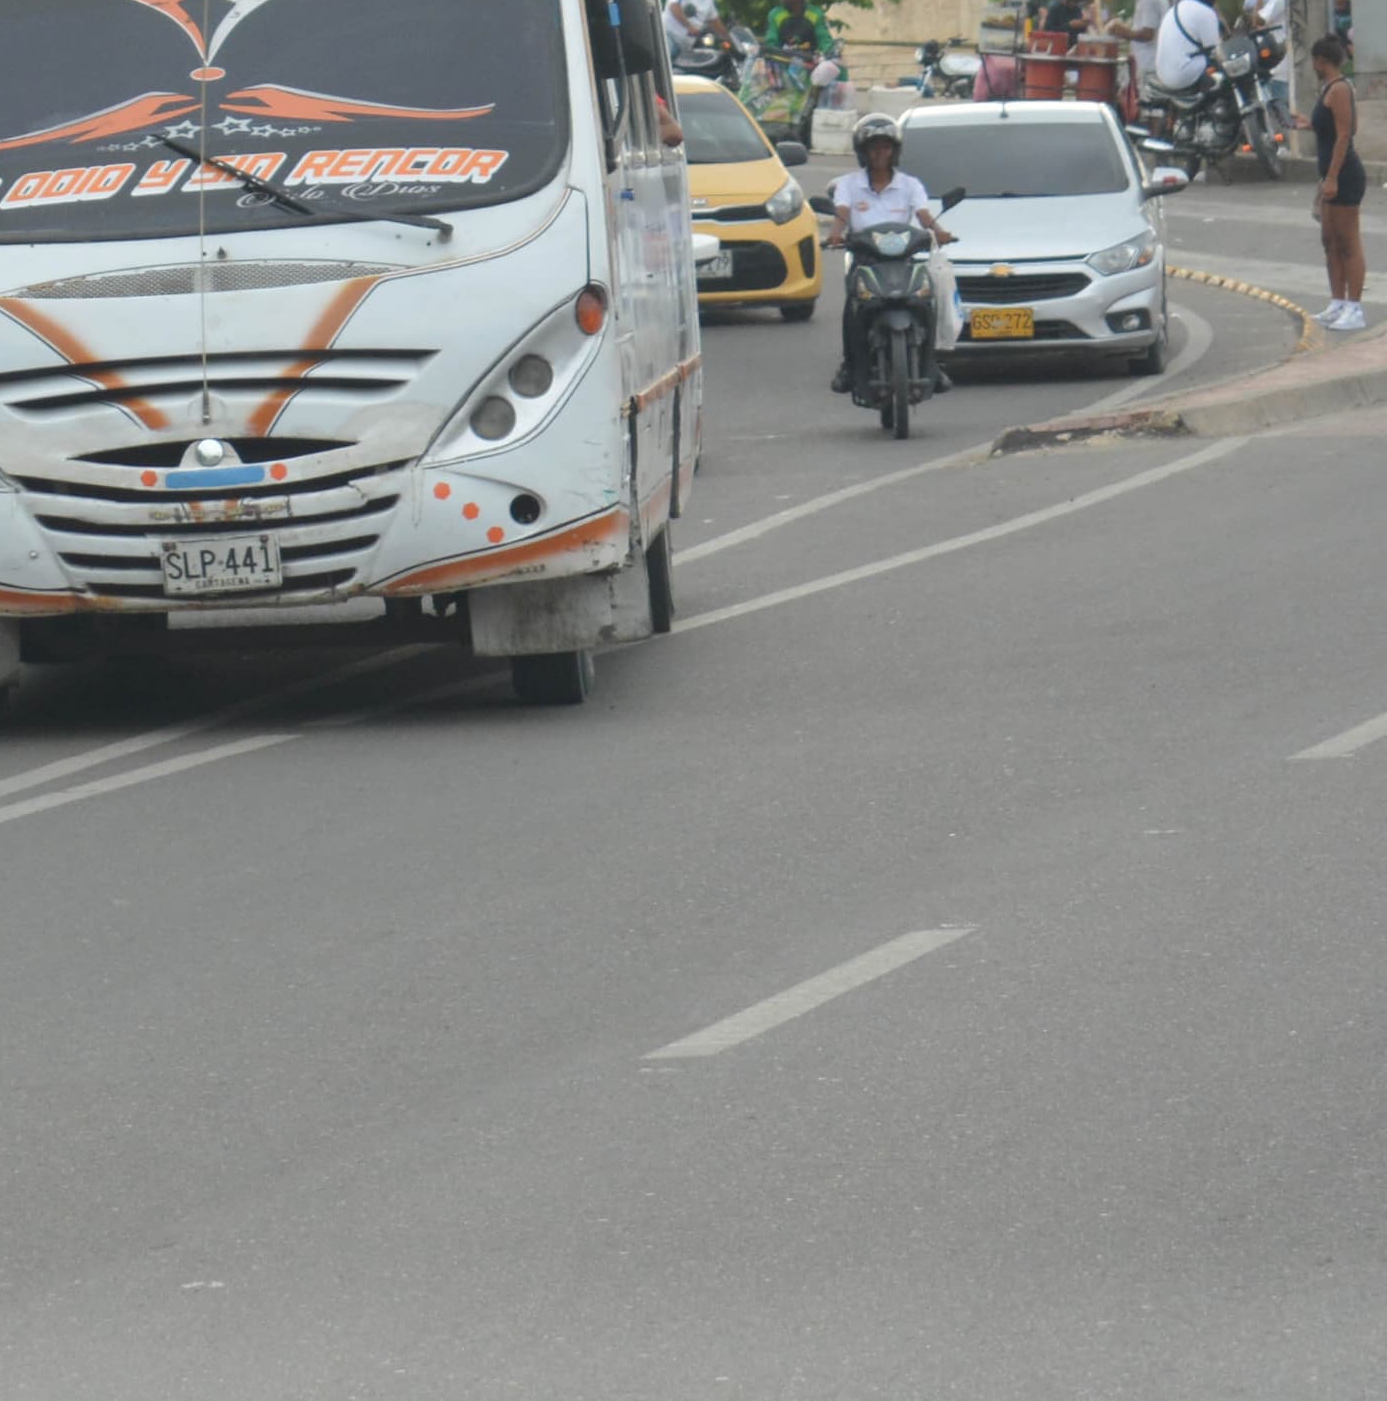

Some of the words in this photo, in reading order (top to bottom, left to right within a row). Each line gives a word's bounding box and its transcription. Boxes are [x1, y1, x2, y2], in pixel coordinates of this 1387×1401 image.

[1, 164, 134, 207] ODIO
[133, 160, 188, 193] Y
[189, 154, 286, 188] SIN
[285, 149, 507, 183] RENCOR
